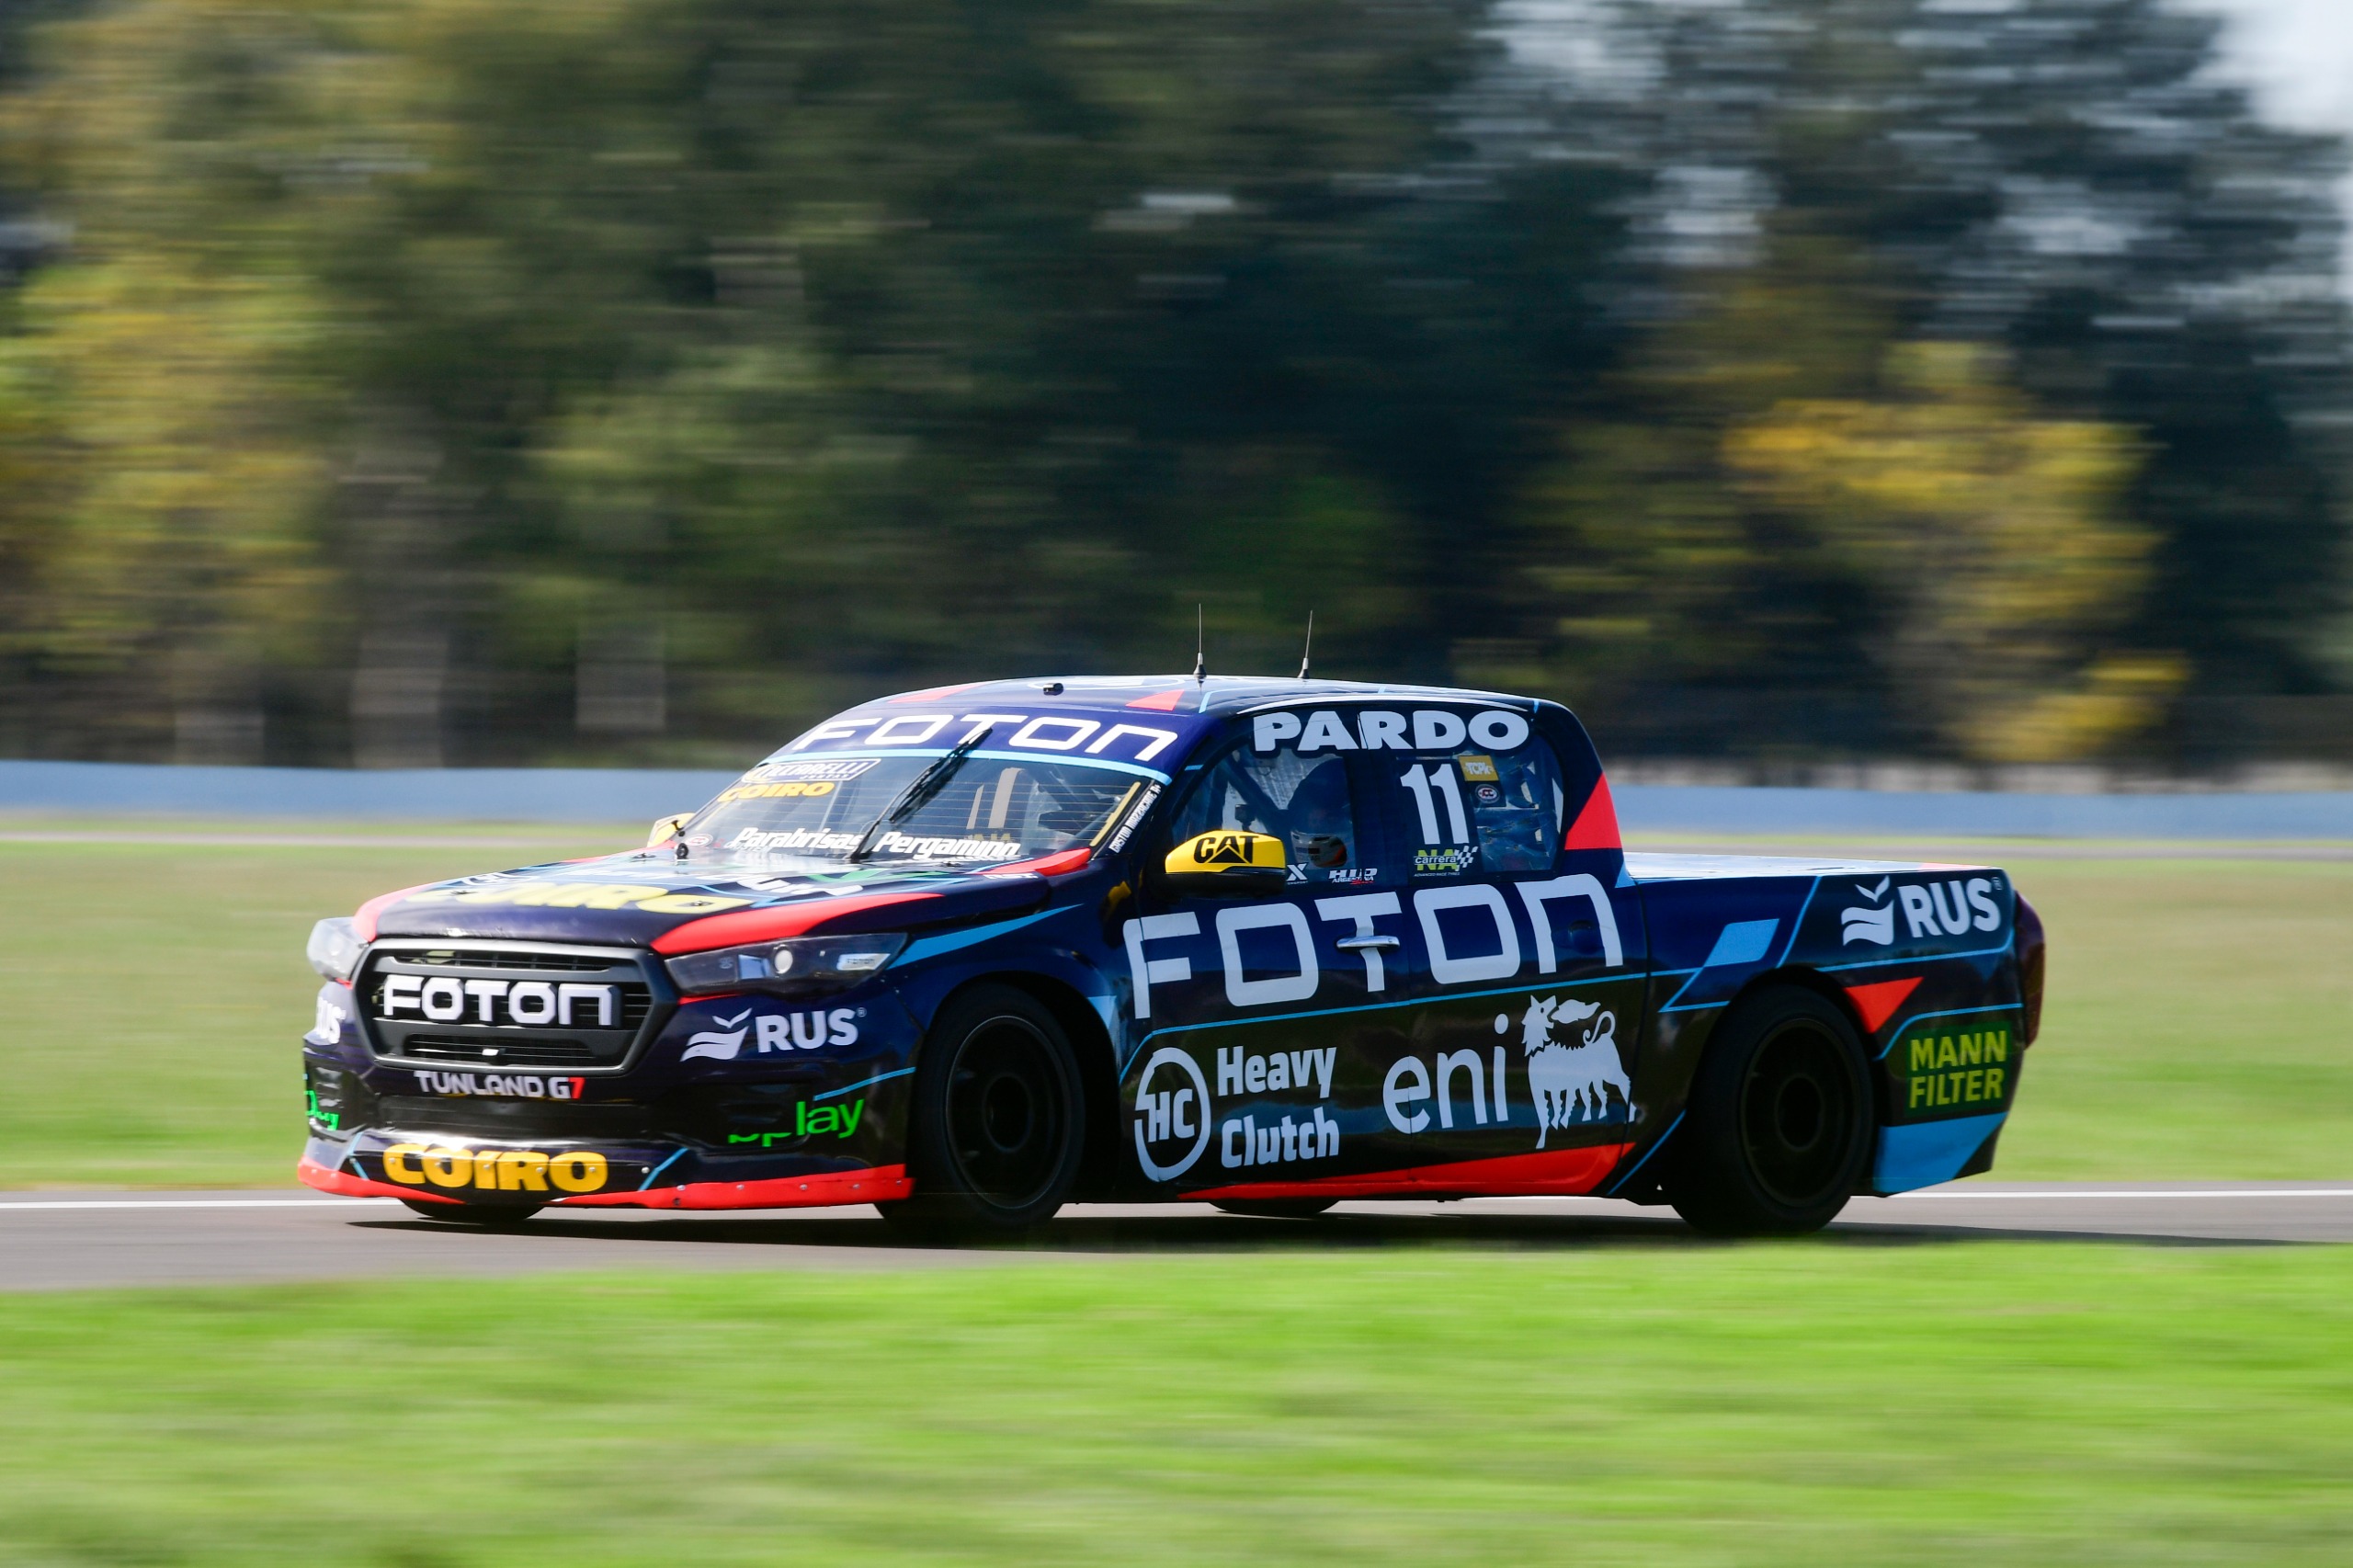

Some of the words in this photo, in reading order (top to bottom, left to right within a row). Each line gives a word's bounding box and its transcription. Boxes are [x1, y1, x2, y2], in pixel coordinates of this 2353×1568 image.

[792, 713, 1178, 762] FOTON
[1254, 710, 1529, 752] PARDO
[718, 781, 836, 802] COIRO
[1400, 764, 1470, 845] 11
[733, 827, 864, 849] Parabrisas
[871, 832, 1021, 860] Pergamino
[1194, 835, 1259, 863] CAT
[1415, 855, 1457, 865] carrera
[1897, 878, 2001, 938] RUS
[1123, 873, 1624, 1019] FOTON
[382, 974, 618, 1028] FOTON
[756, 1008, 858, 1053] RUS
[1910, 1030, 2006, 1072] MANN
[414, 1071, 545, 1097] TUNLAND
[548, 1076, 585, 1099] G7
[1217, 1046, 1336, 1098] Heavy
[1382, 1013, 1509, 1134] eni
[1909, 1068, 2004, 1108] FILTER
[1221, 1107, 1340, 1168] Clutch
[382, 1143, 608, 1192] COIRO
